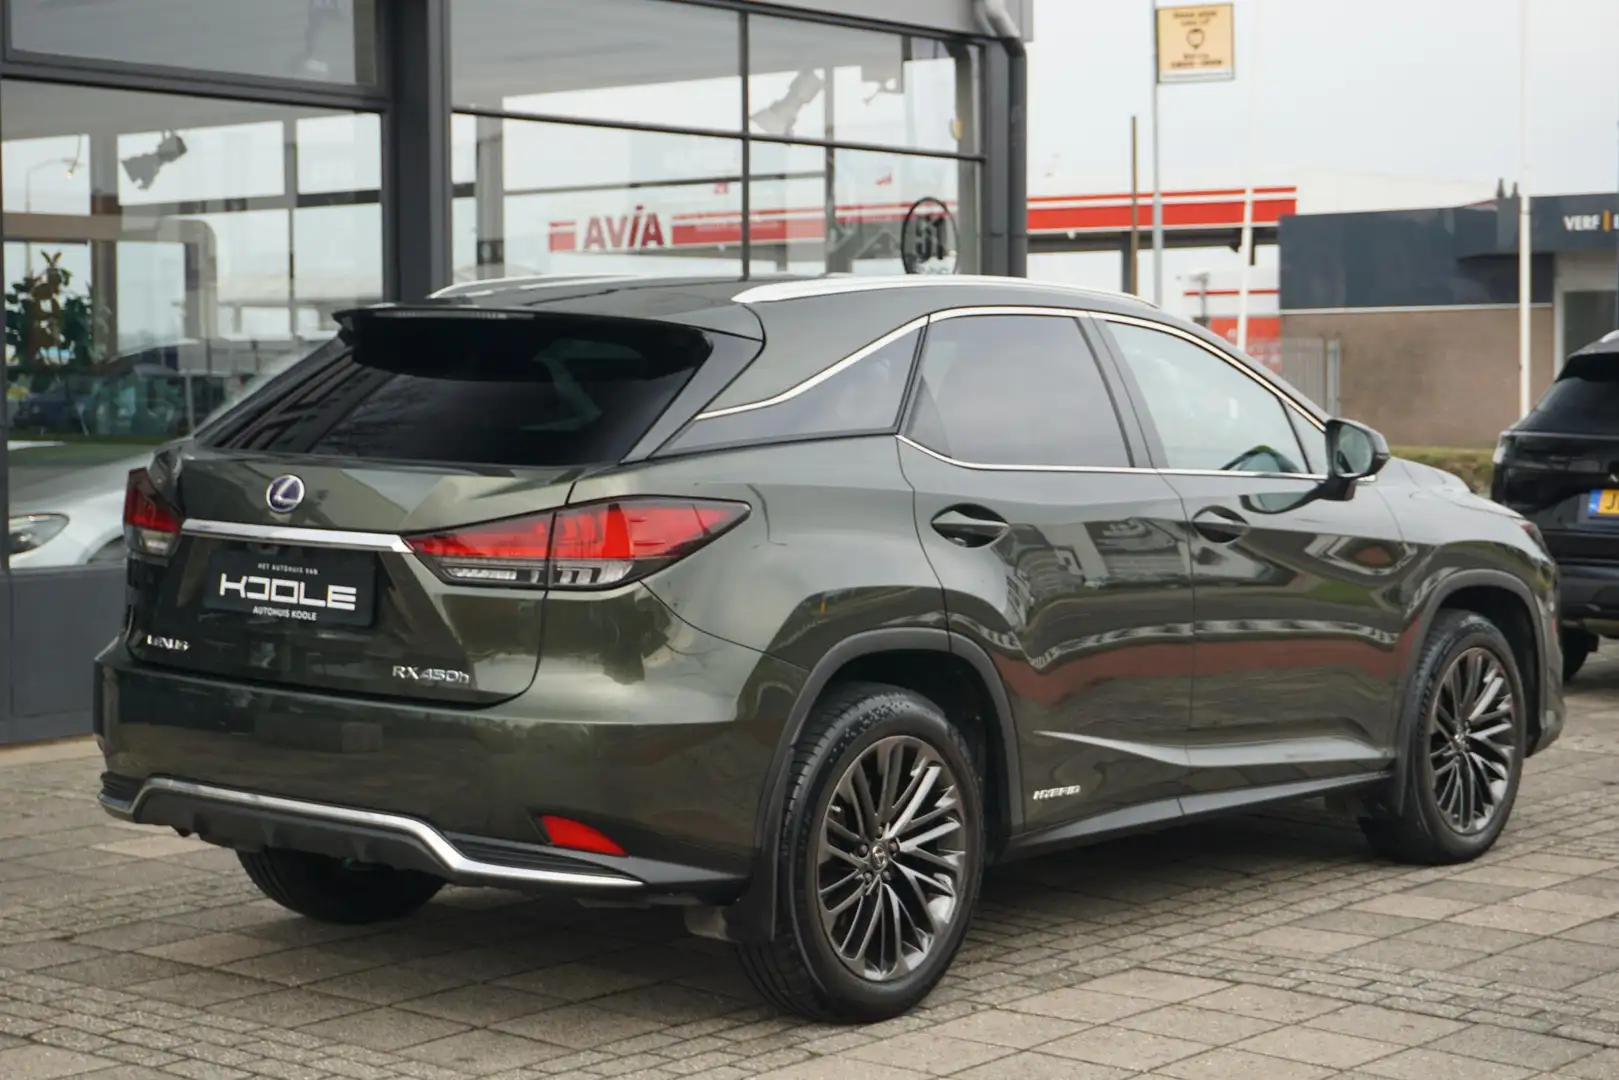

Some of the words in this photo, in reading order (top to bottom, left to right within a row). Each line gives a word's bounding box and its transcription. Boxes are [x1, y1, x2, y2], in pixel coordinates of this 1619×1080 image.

[1562, 214, 1600, 231] VERF
[271, 563, 303, 574] AUTOHUIS
[219, 573, 357, 611] KOOLE
[252, 605, 290, 619] AUTOHUIS
[291, 611, 318, 622] KOOLE
[392, 665, 419, 680] RX
[420, 668, 470, 684] 450h
